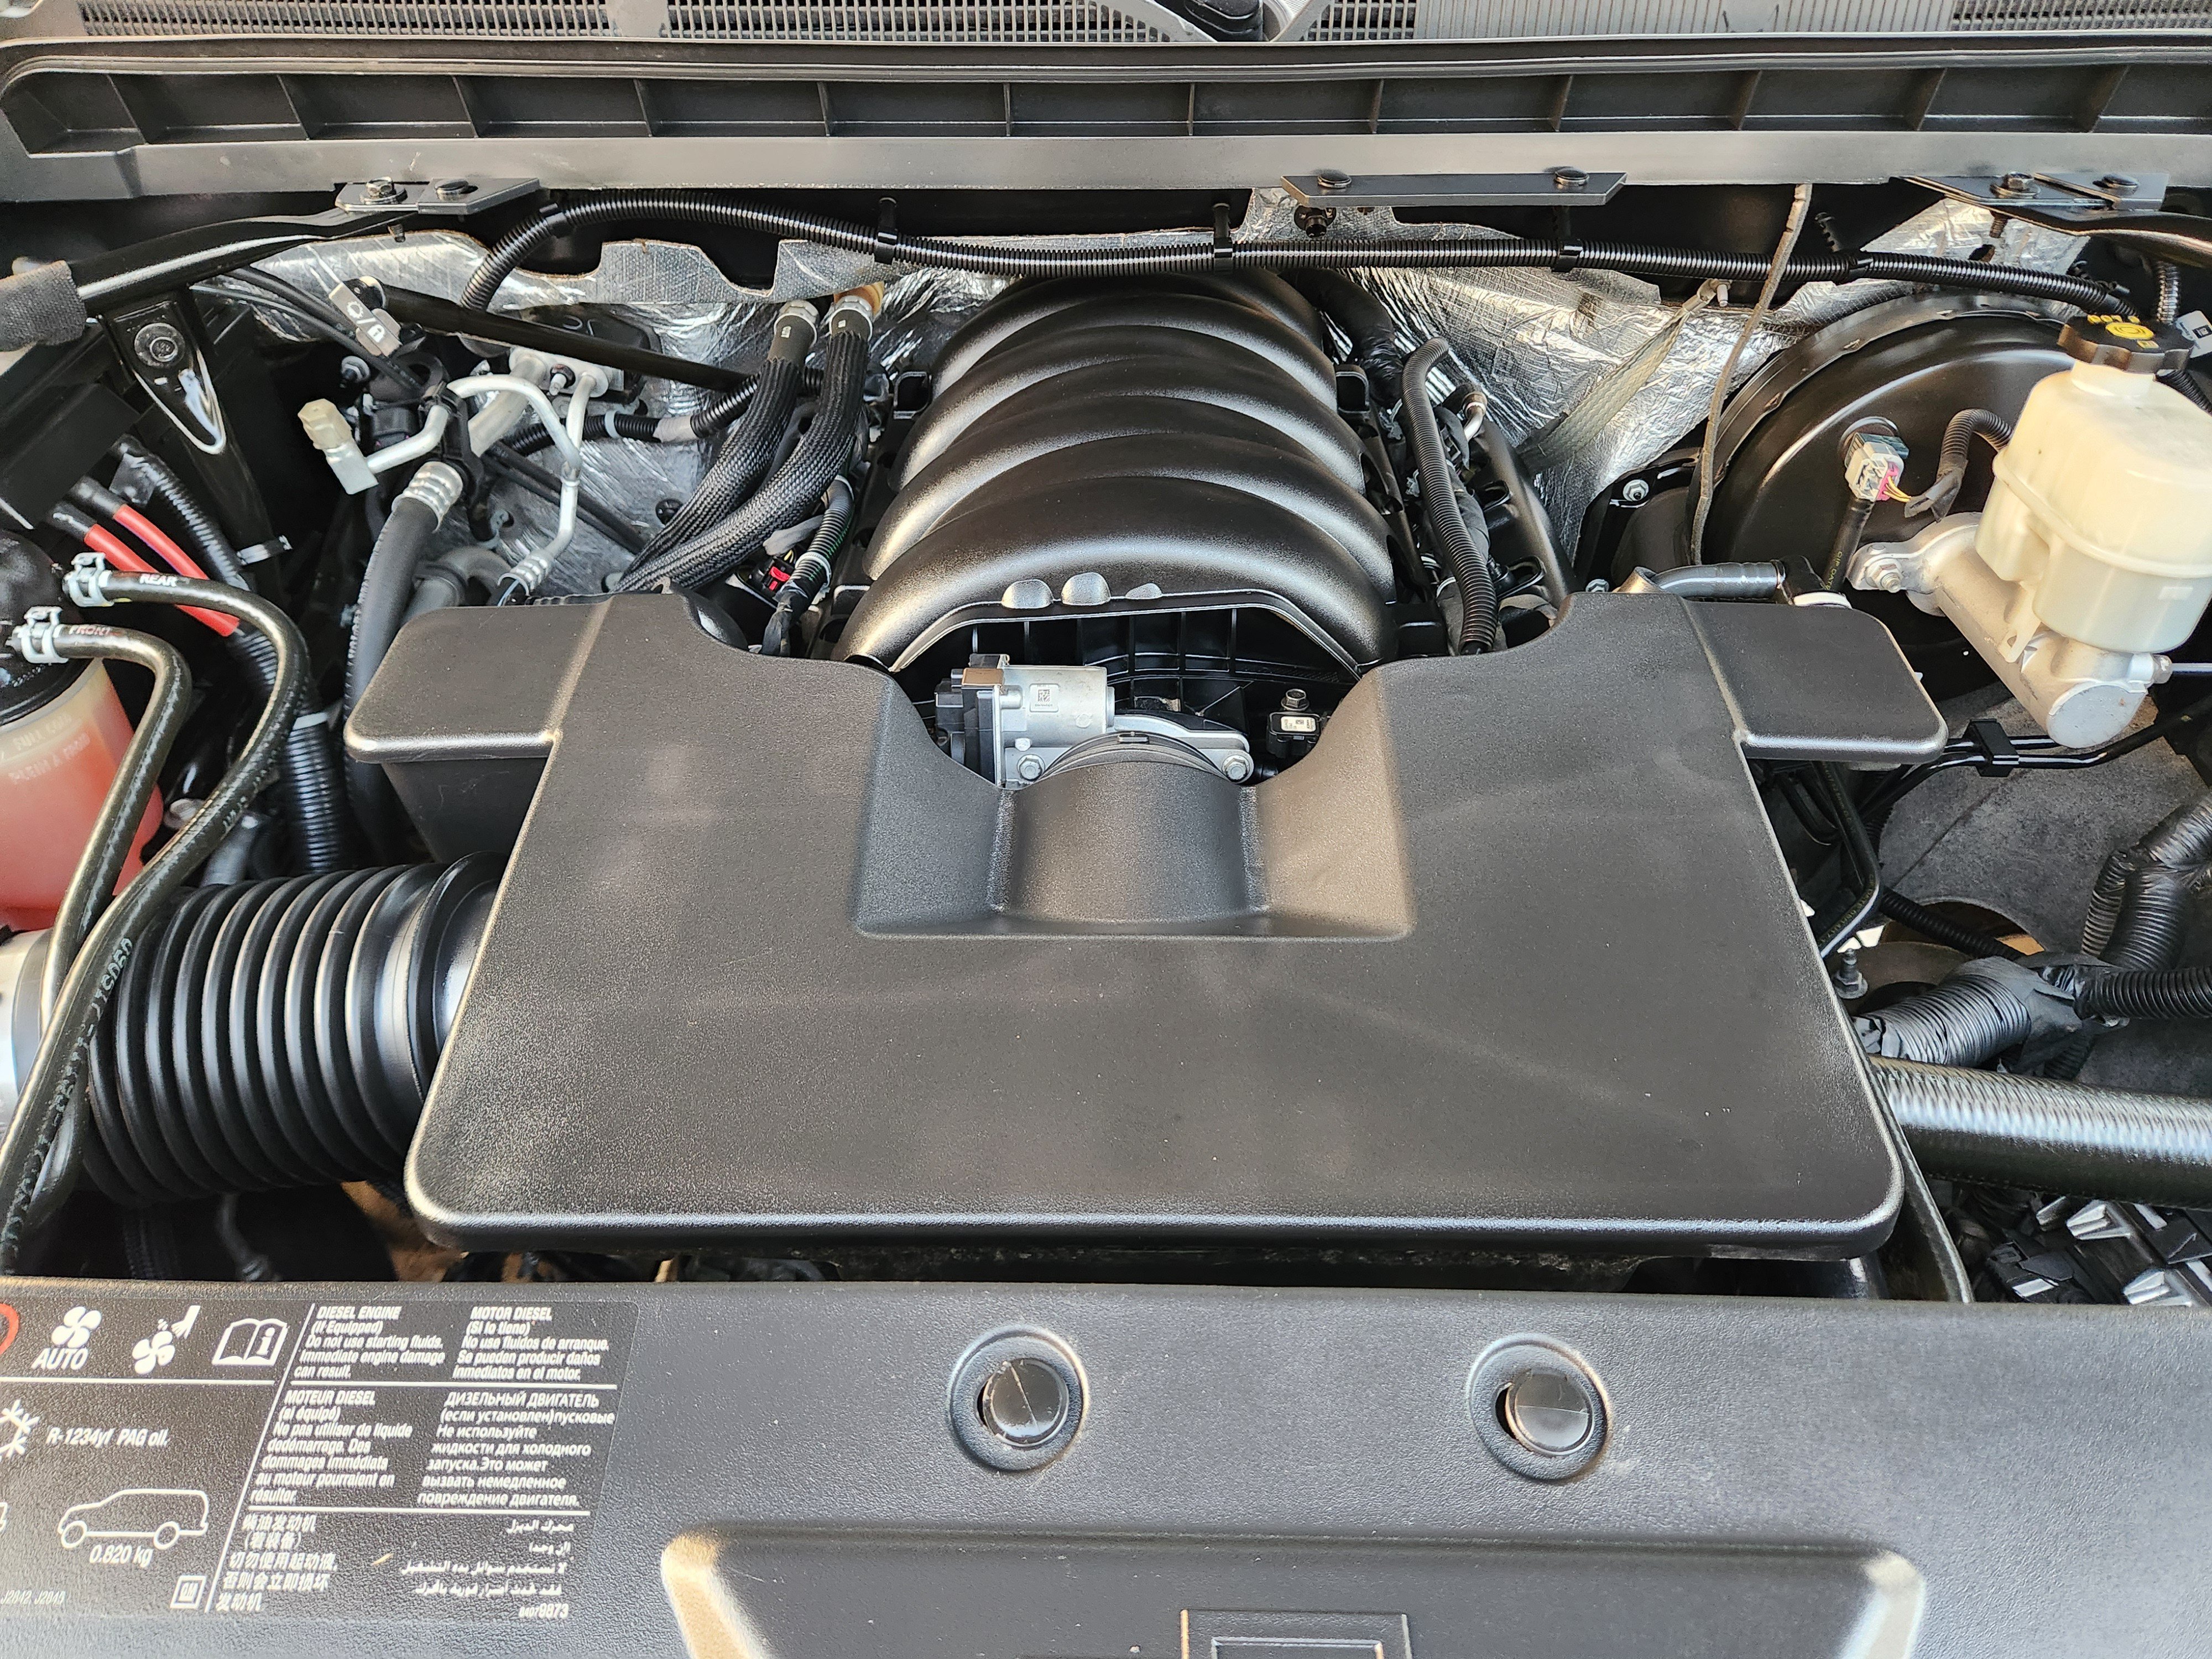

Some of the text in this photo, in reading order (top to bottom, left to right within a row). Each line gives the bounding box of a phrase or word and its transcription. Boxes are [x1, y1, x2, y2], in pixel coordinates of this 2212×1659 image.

[139, 573, 178, 587] REAR
[69, 624, 112, 635] FRONT
[316, 1306, 402, 1320] DIESEL ENGINE
[470, 1306, 552, 1321] MOTOR DIESEL
[497, 1321, 530, 1337] tiene)
[305, 1334, 443, 1351] Do not use starting fluids.
[461, 1335, 609, 1353] No use fluidos de arranque.
[31, 1348, 88, 1370] AUTO
[299, 1349, 445, 1366] Immediate engine damage
[457, 1349, 601, 1367] Se pueden producir daños
[294, 1364, 351, 1379] can result.
[516, 1368, 531, 1380] en
[533, 1366, 545, 1380] el
[545, 1366, 581, 1381] motor.
[284, 1389, 375, 1406] MOTEUR DIESEL
[444, 1390, 600, 1409] ДИЗЕЛЬНЫЙ ДВИГАТЕЛЬ
[440, 1408, 475, 1424] (если
[46, 1427, 116, 1448] R-1234yf
[116, 1428, 149, 1446] PAG
[290, 1424, 314, 1439] pas
[314, 1422, 356, 1438] utiliser
[356, 1422, 372, 1438] de
[372, 1422, 413, 1440] liquide
[436, 1424, 538, 1441] Не используйте
[347, 1438, 372, 1454] Des
[431, 1442, 592, 1458] жидкости для холодного
[261, 1454, 326, 1473] dommages
[505, 1460, 549, 1473] может
[255, 1472, 395, 1490] au moteur pourraient en
[422, 1475, 567, 1490] вызвать немедленное
[418, 1493, 581, 1508] повреждение двигателя.
[89, 1545, 154, 1568] 0.820 kg
[216, 1592, 263, 1612] 发动机
